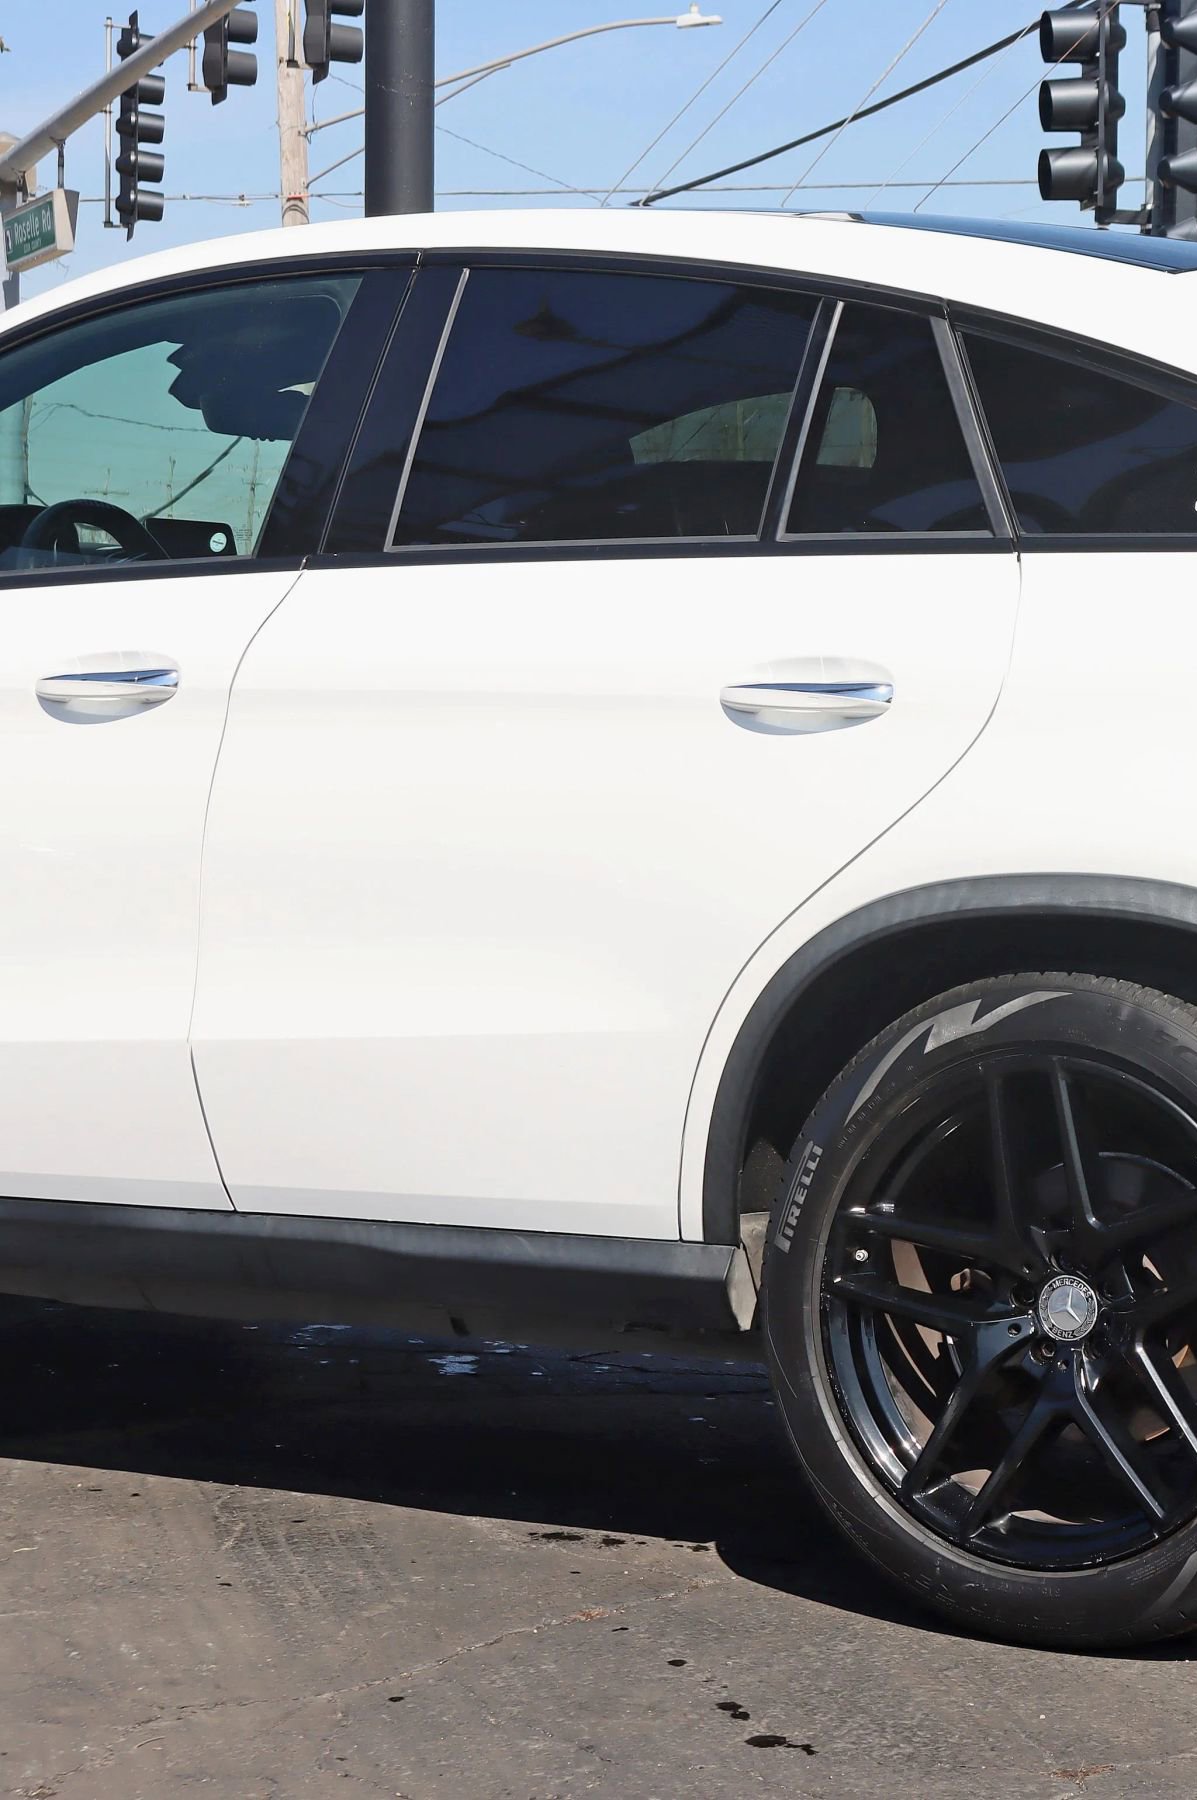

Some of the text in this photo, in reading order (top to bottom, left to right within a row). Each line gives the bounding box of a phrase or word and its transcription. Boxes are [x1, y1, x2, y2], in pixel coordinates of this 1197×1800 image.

[14, 206, 52, 244] Roselle Rd
[774, 1140, 824, 1254] PIRELLI
[1052, 1278, 1092, 1299] MERCEDES
[1052, 1327, 1074, 1339] BENZ
